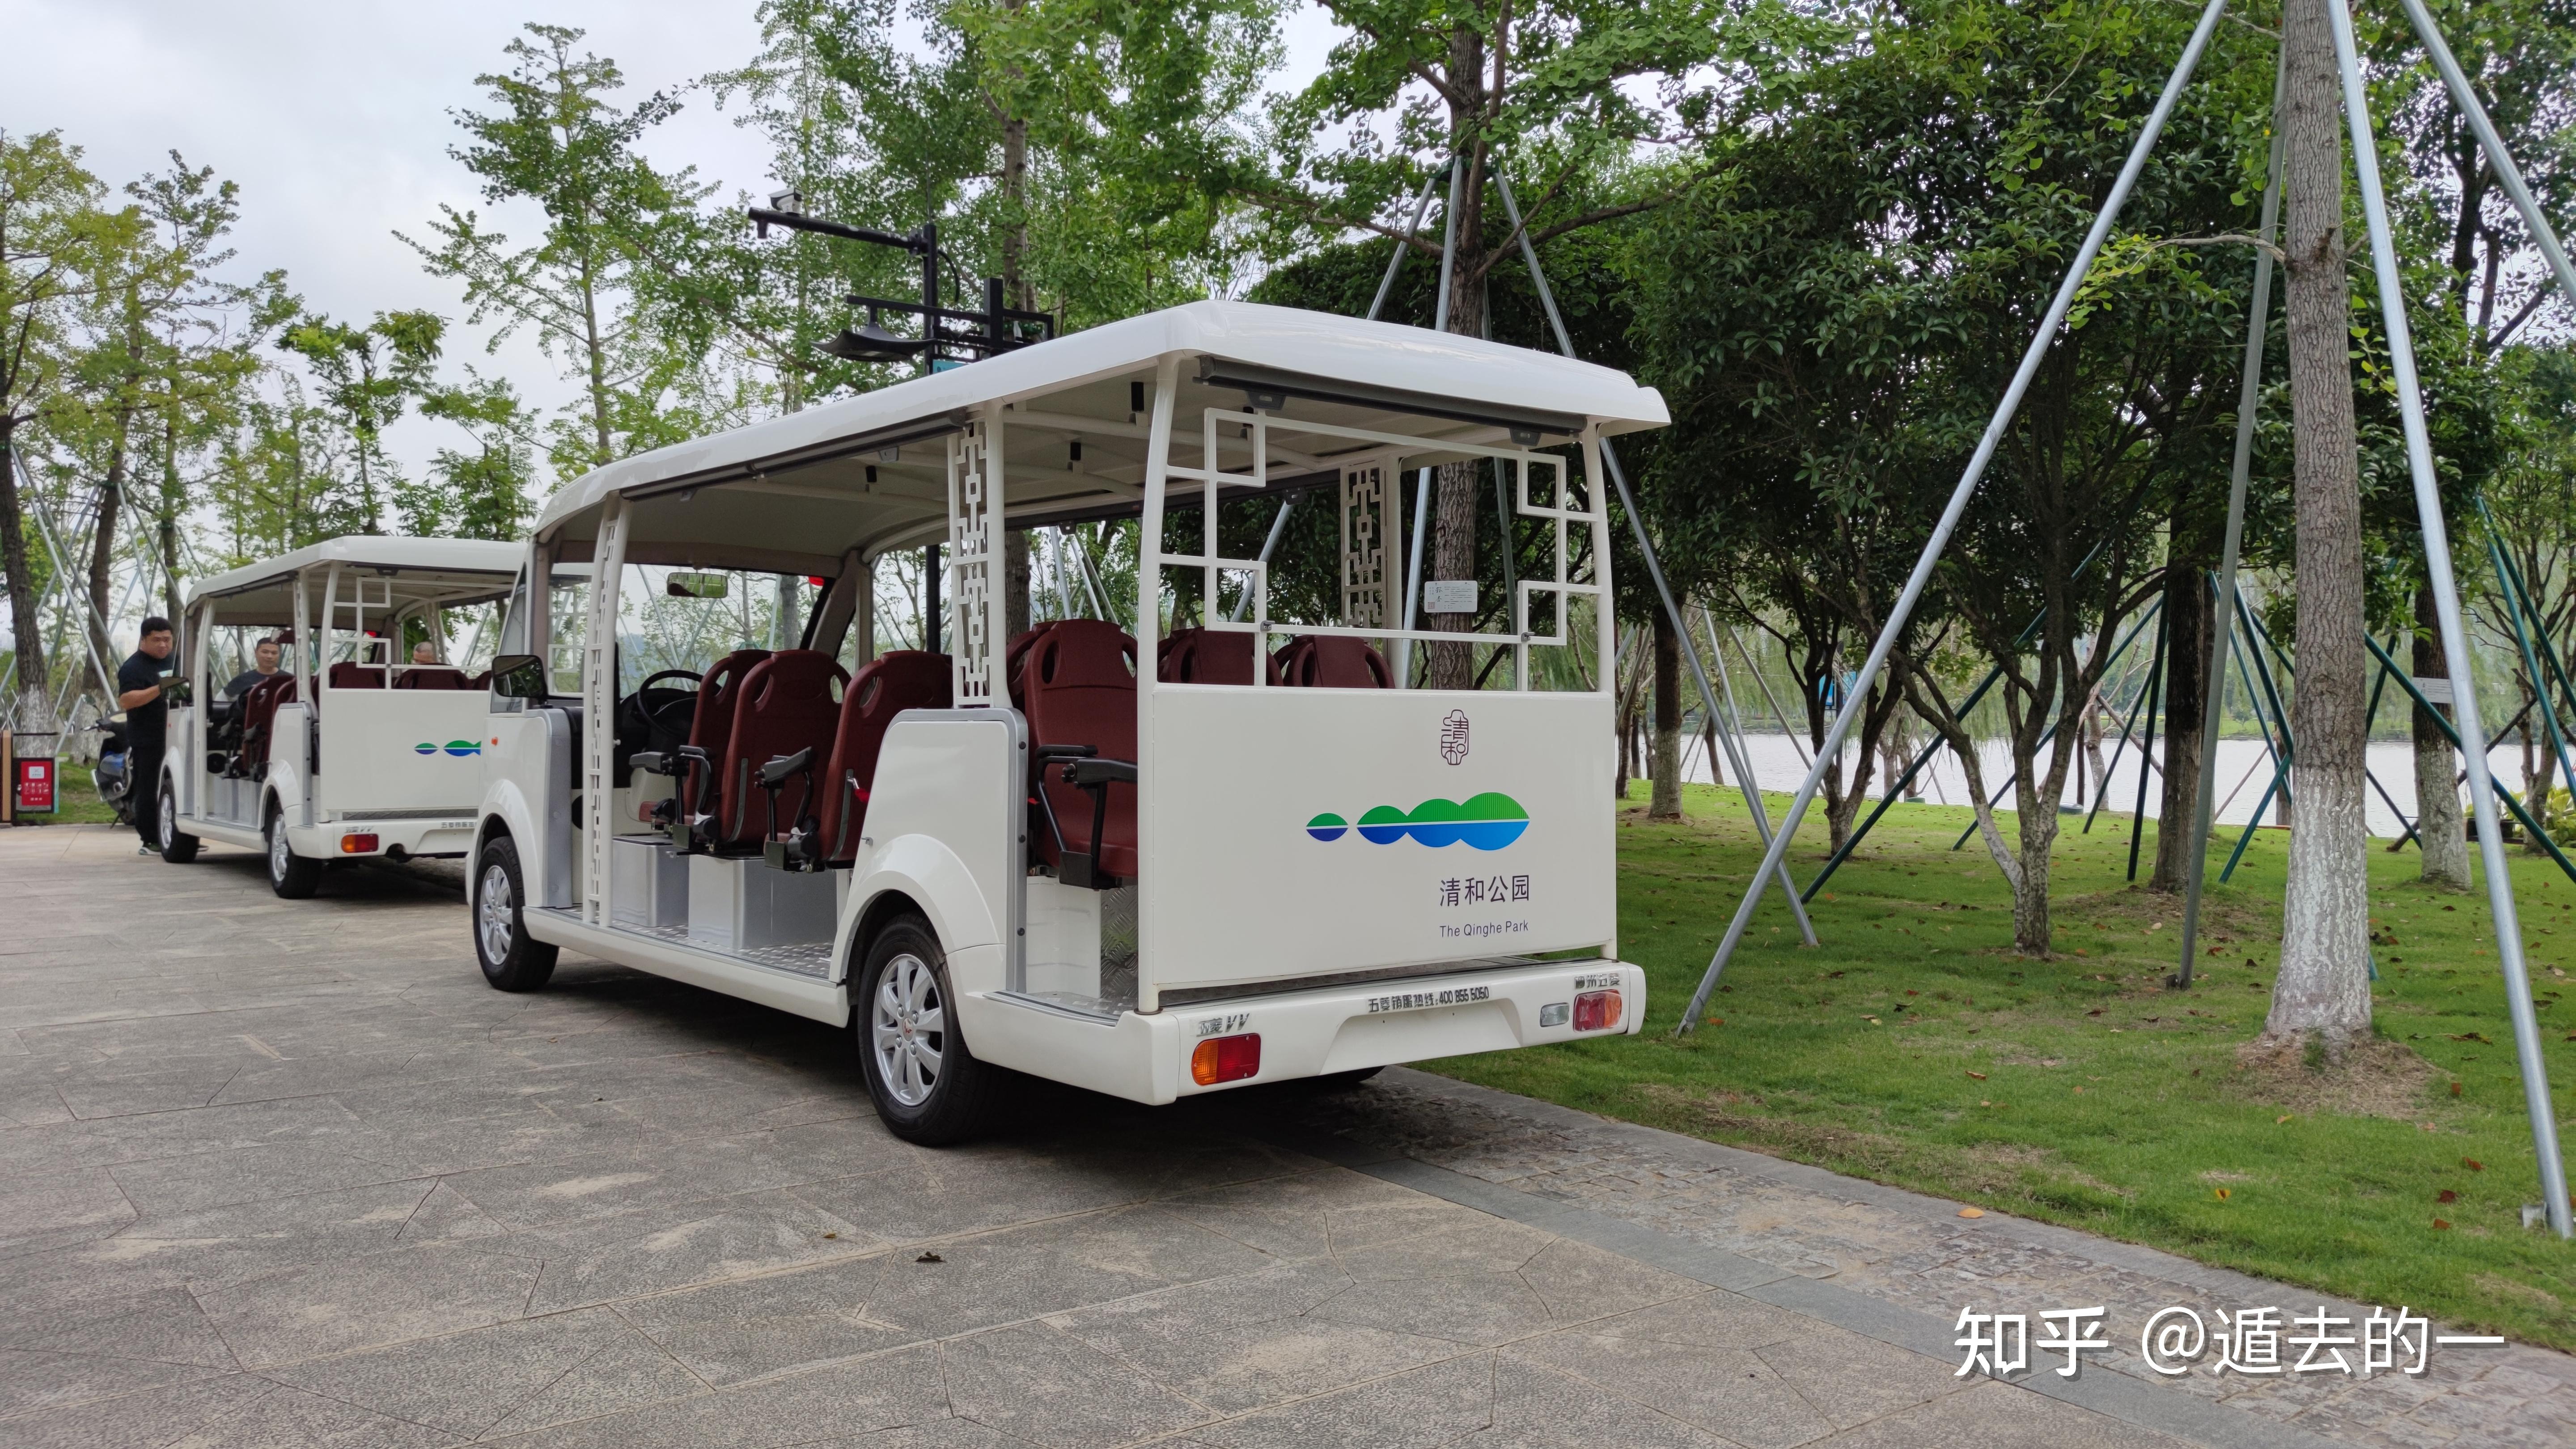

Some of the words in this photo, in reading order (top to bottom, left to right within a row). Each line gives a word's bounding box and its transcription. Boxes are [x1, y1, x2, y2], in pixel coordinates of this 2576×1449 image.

[1439, 875, 1530, 907] 清和公园
[1440, 925, 1460, 938] The
[1464, 922, 1502, 937] Qinghe
[1505, 919, 1529, 933] Park
[1455, 988, 1469, 1003] 855
[1470, 986, 1490, 1000] 5050
